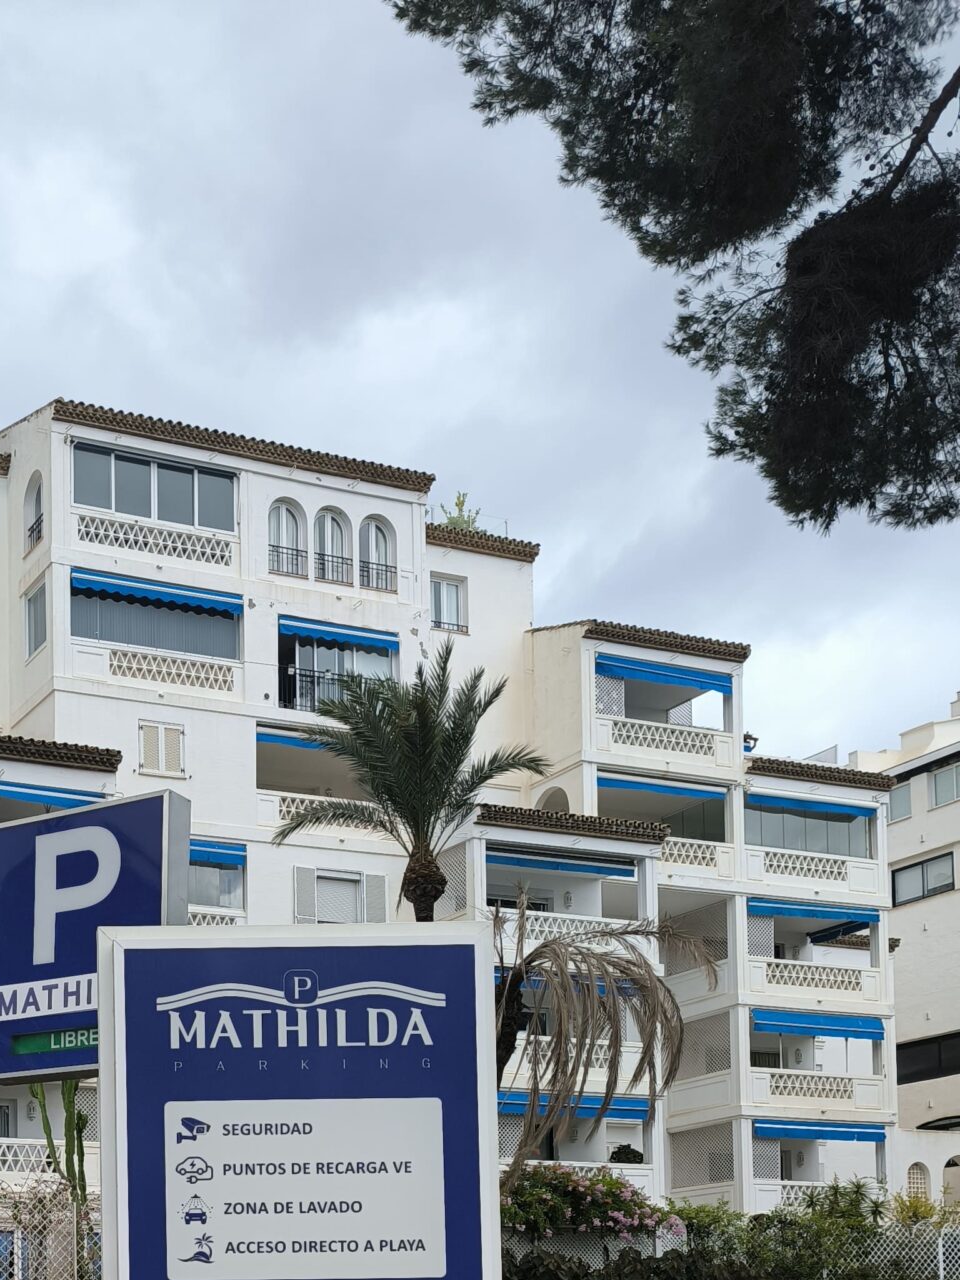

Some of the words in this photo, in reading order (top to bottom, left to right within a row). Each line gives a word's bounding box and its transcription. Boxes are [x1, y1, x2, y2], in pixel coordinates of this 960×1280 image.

[33, 825, 122, 966] P
[293, 976, 312, 1000] P
[168, 1007, 434, 1050] MATHILDA
[50, 1028, 99, 1049] LIBRE
[173, 1057, 431, 1073] PARKING
[221, 1122, 313, 1137] SEGURIDAD
[222, 1162, 287, 1176] PUNTOS
[291, 1162, 311, 1175] DE
[315, 1161, 389, 1175] RECARGA
[392, 1161, 413, 1174] VE
[223, 1202, 269, 1215] ZONA
[273, 1201, 294, 1214] DE
[299, 1200, 363, 1214] LAVADO
[224, 1240, 287, 1254] ACCESO
[291, 1240, 359, 1253] DIRECTO
[363, 1240, 375, 1252] A
[379, 1239, 426, 1252] PLAYA
